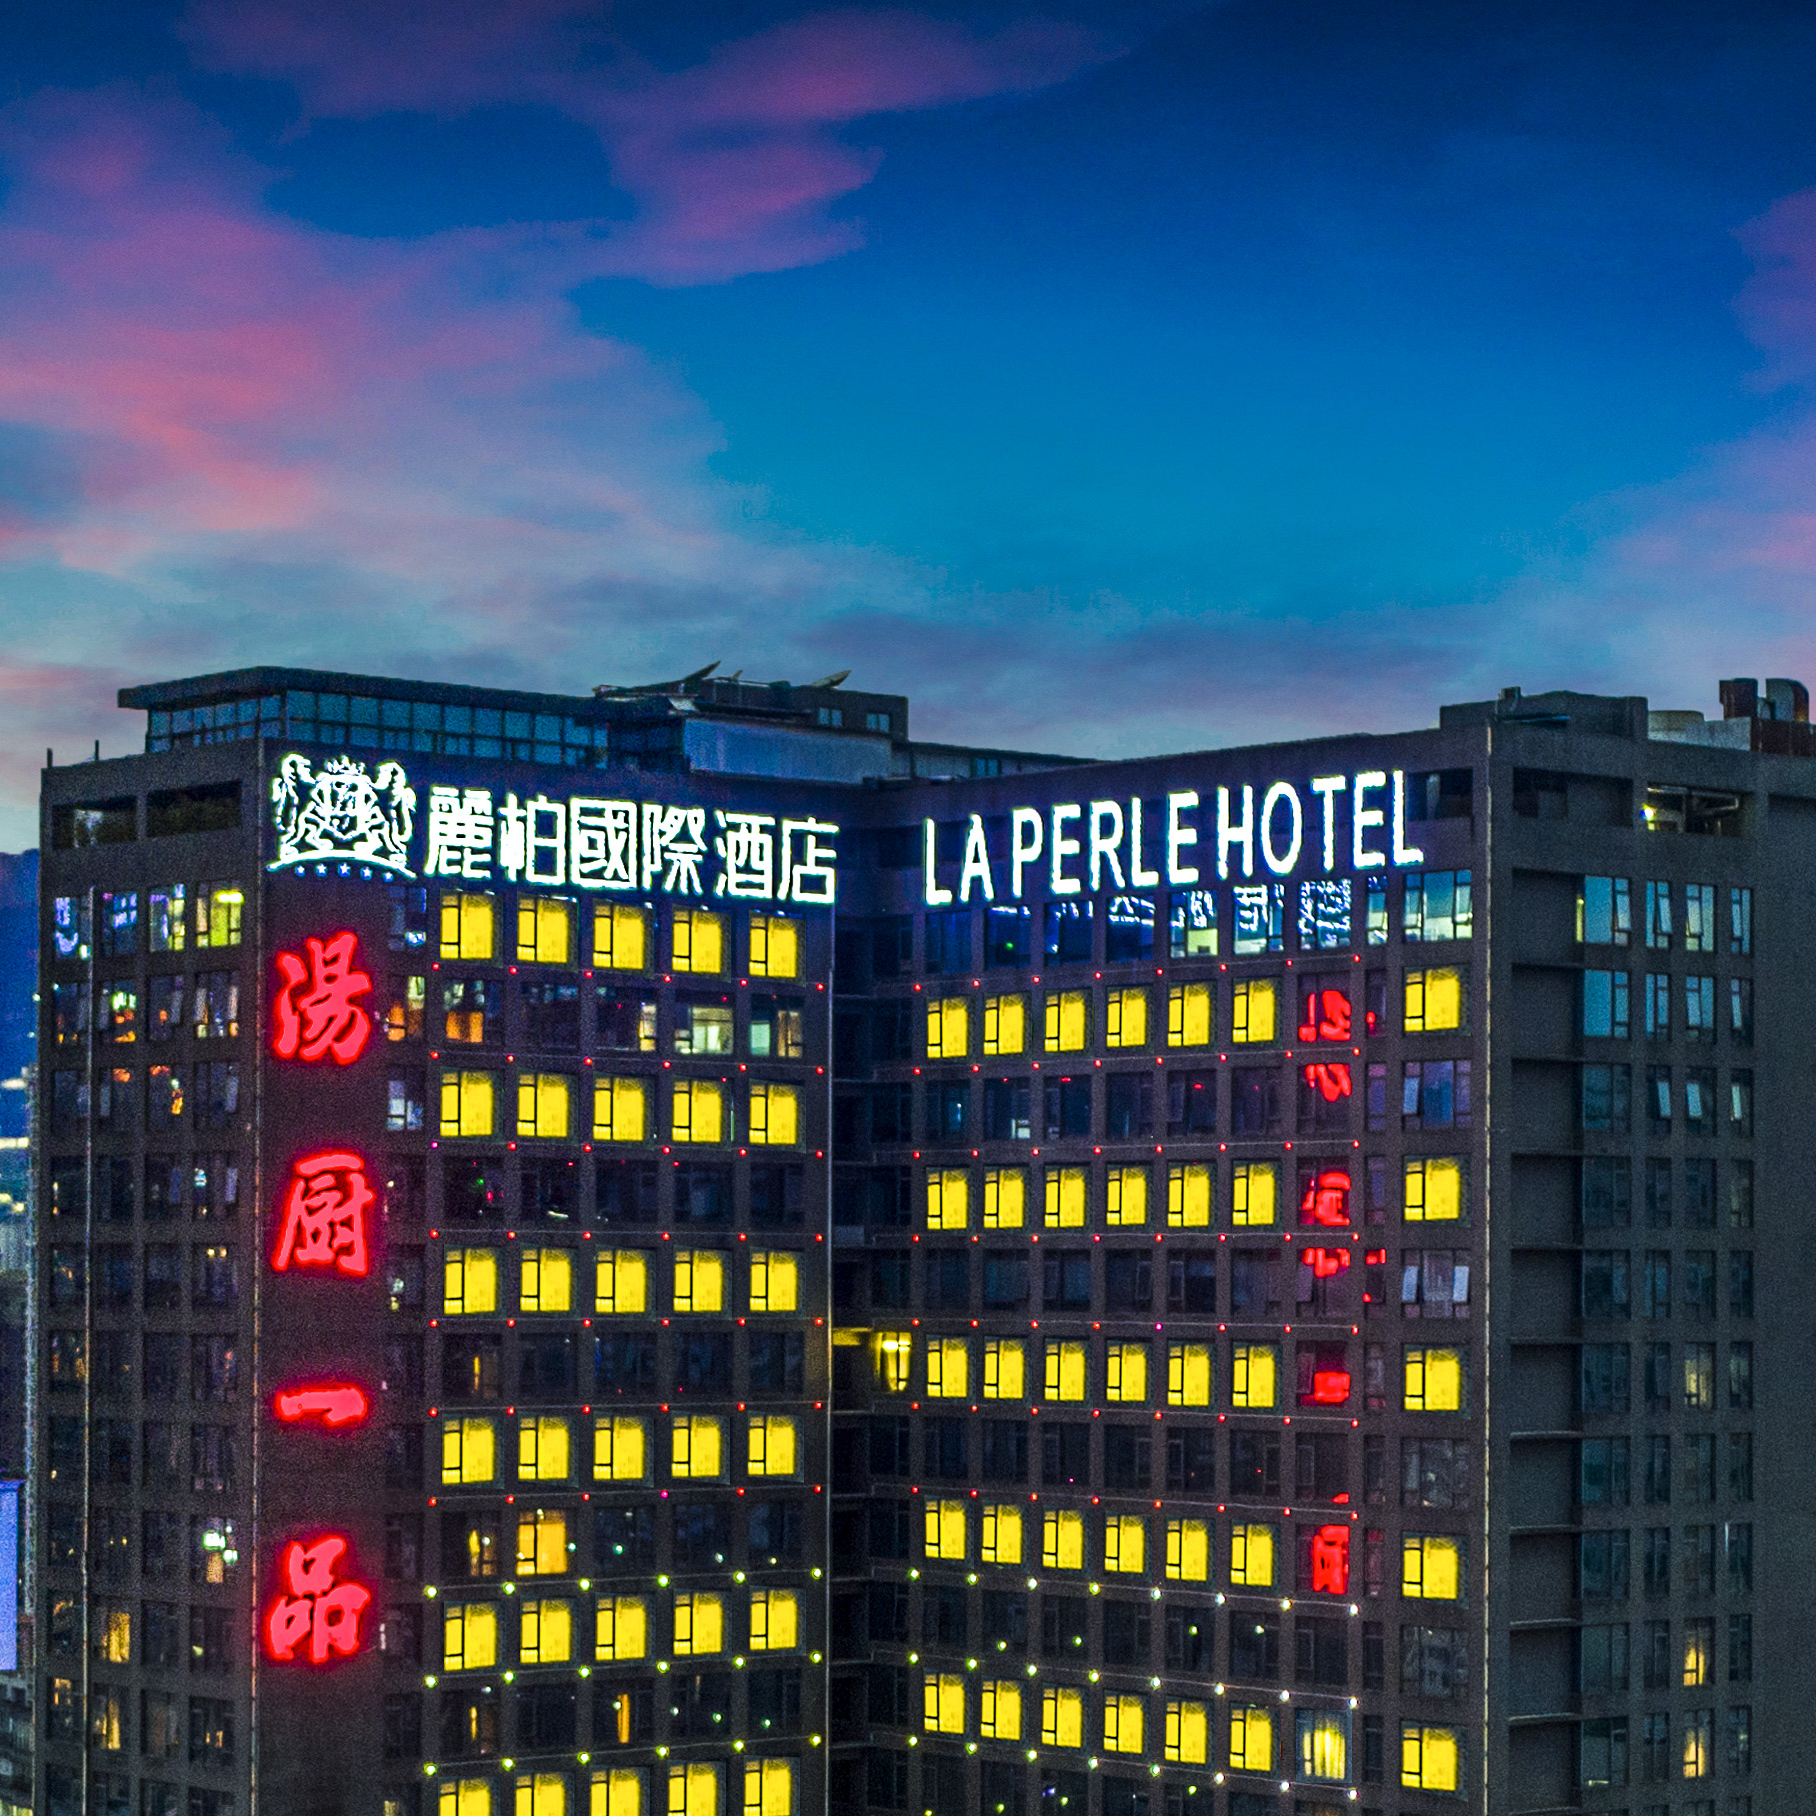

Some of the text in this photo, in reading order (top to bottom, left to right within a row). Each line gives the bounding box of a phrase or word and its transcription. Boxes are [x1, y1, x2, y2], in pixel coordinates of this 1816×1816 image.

[424, 786, 839, 904] 麗柏國際酒店
[924, 769, 1425, 906] LA PERLE HOTEL
